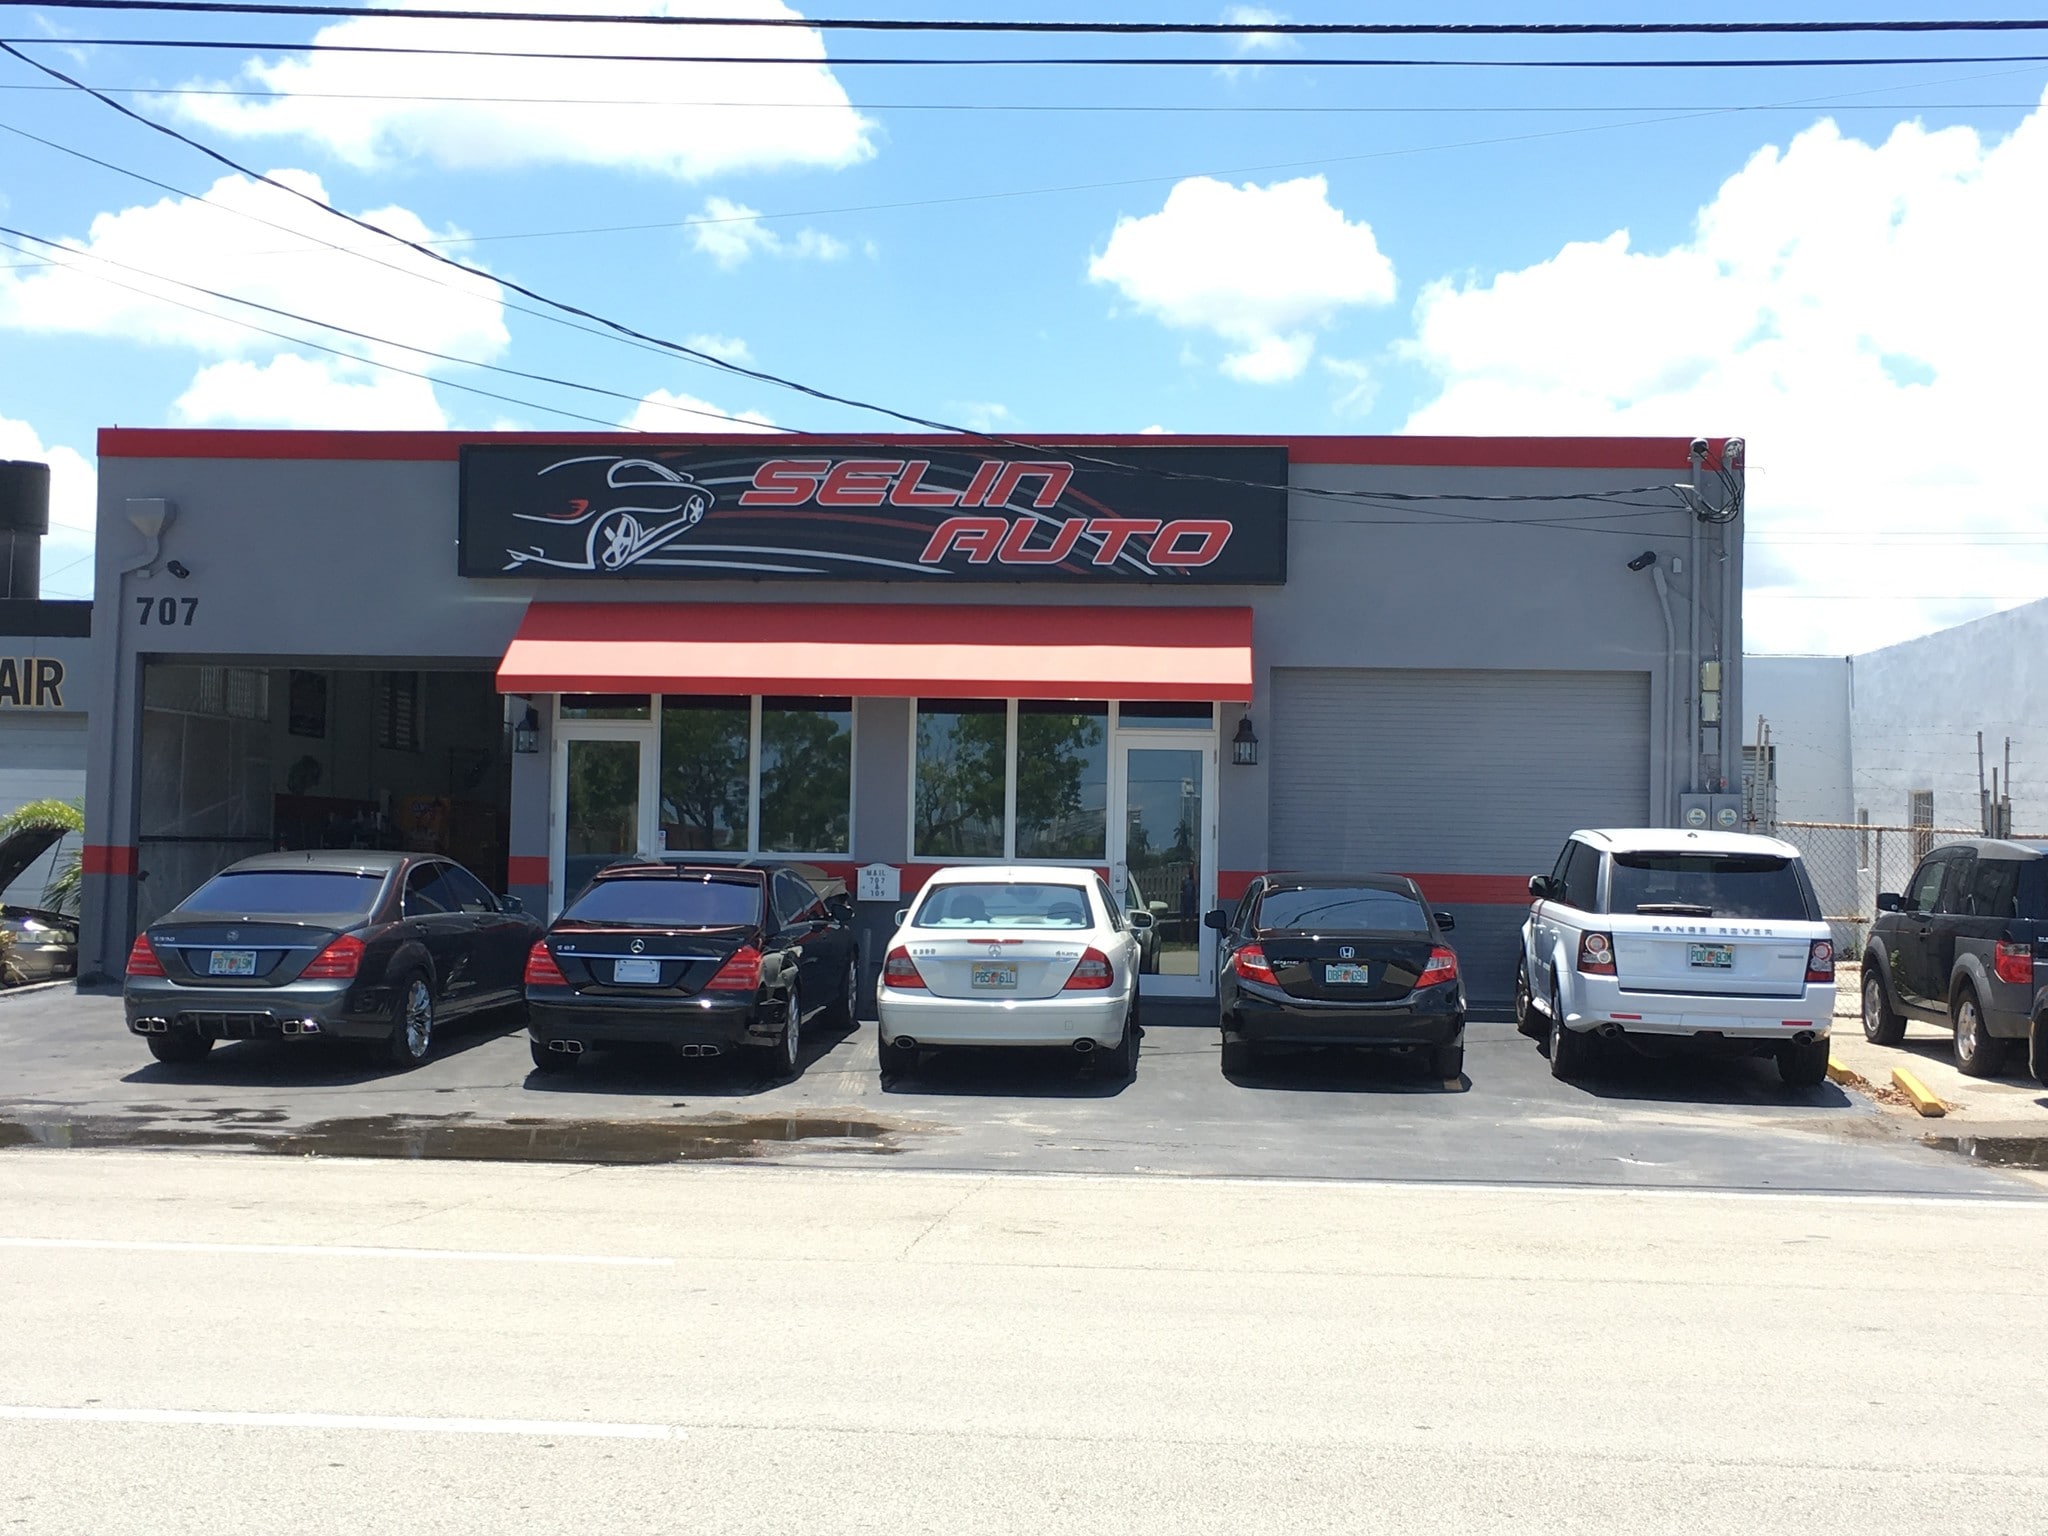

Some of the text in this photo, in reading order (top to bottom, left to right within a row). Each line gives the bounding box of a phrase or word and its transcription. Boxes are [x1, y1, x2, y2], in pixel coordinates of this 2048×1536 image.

[738, 459, 1074, 508] SELIN
[918, 516, 1233, 567] AUTO
[136, 597, 199, 626] 707
[0, 657, 64, 708] AIR
[1652, 925, 1773, 936] RANGE ROVER
